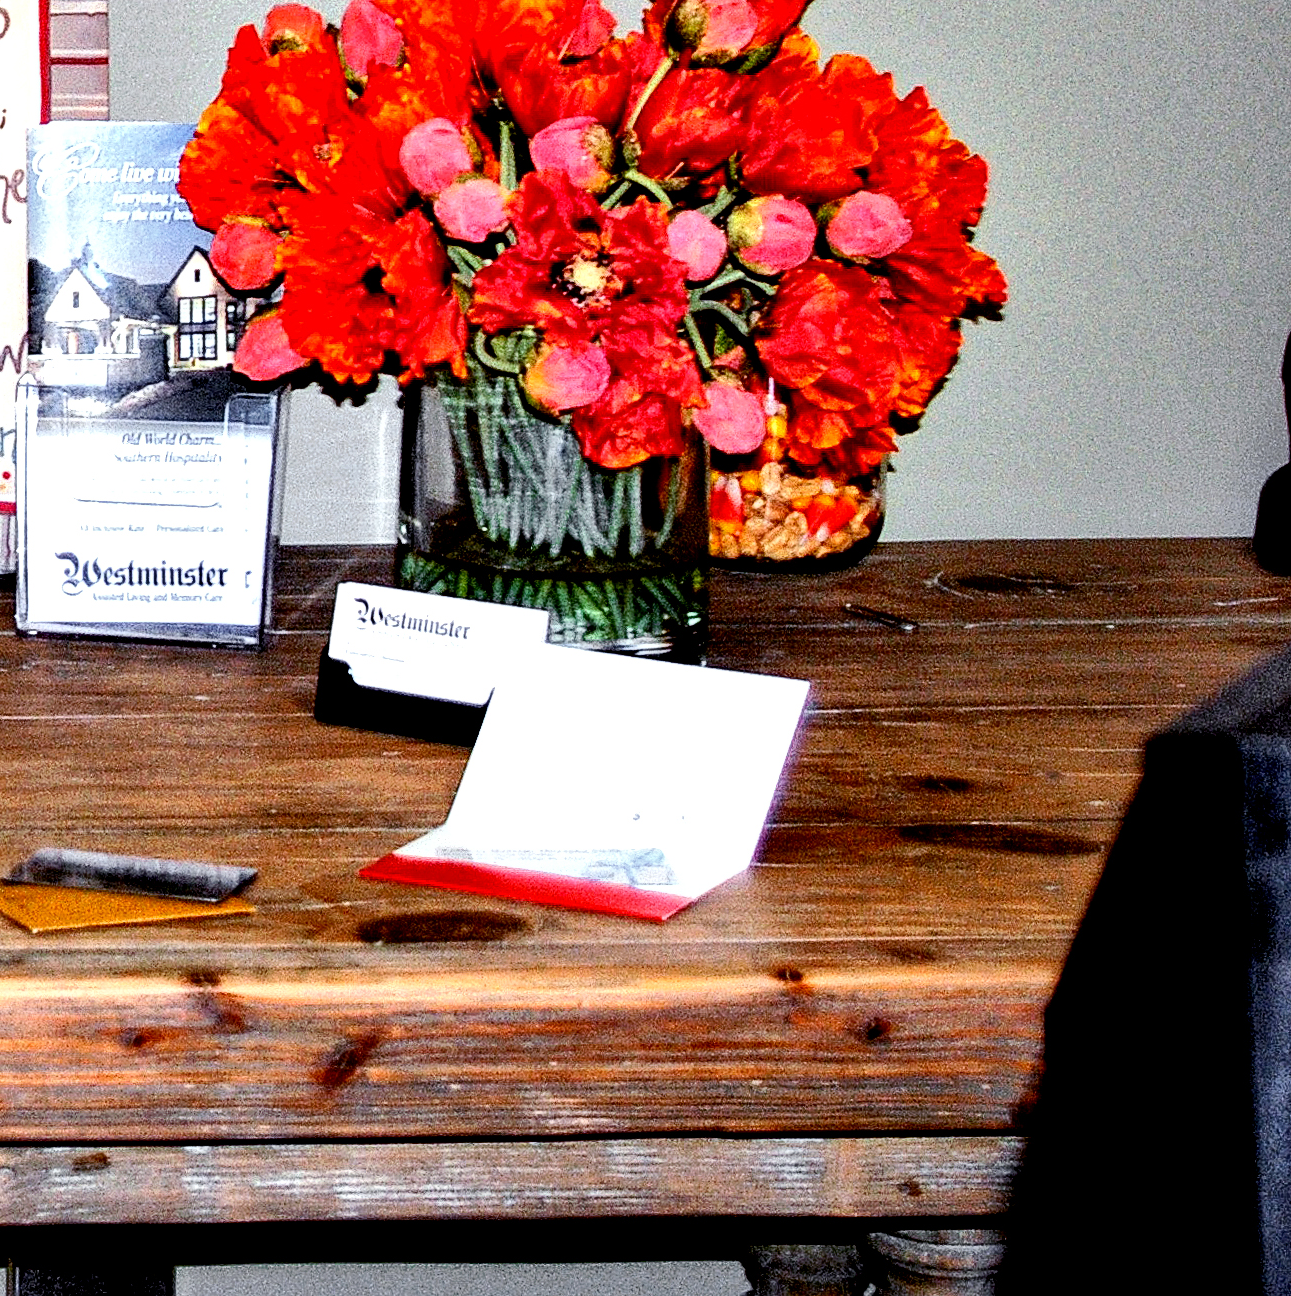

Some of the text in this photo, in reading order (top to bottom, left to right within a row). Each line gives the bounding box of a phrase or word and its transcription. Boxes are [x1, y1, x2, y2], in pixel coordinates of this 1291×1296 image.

[32, 142, 118, 199] Come
[120, 162, 154, 183] live
[122, 433, 142, 446] Old
[145, 433, 177, 446] World
[54, 551, 229, 597] Westminster
[126, 592, 152, 603] Living
[154, 592, 168, 602] and
[353, 597, 471, 641] Westminster
